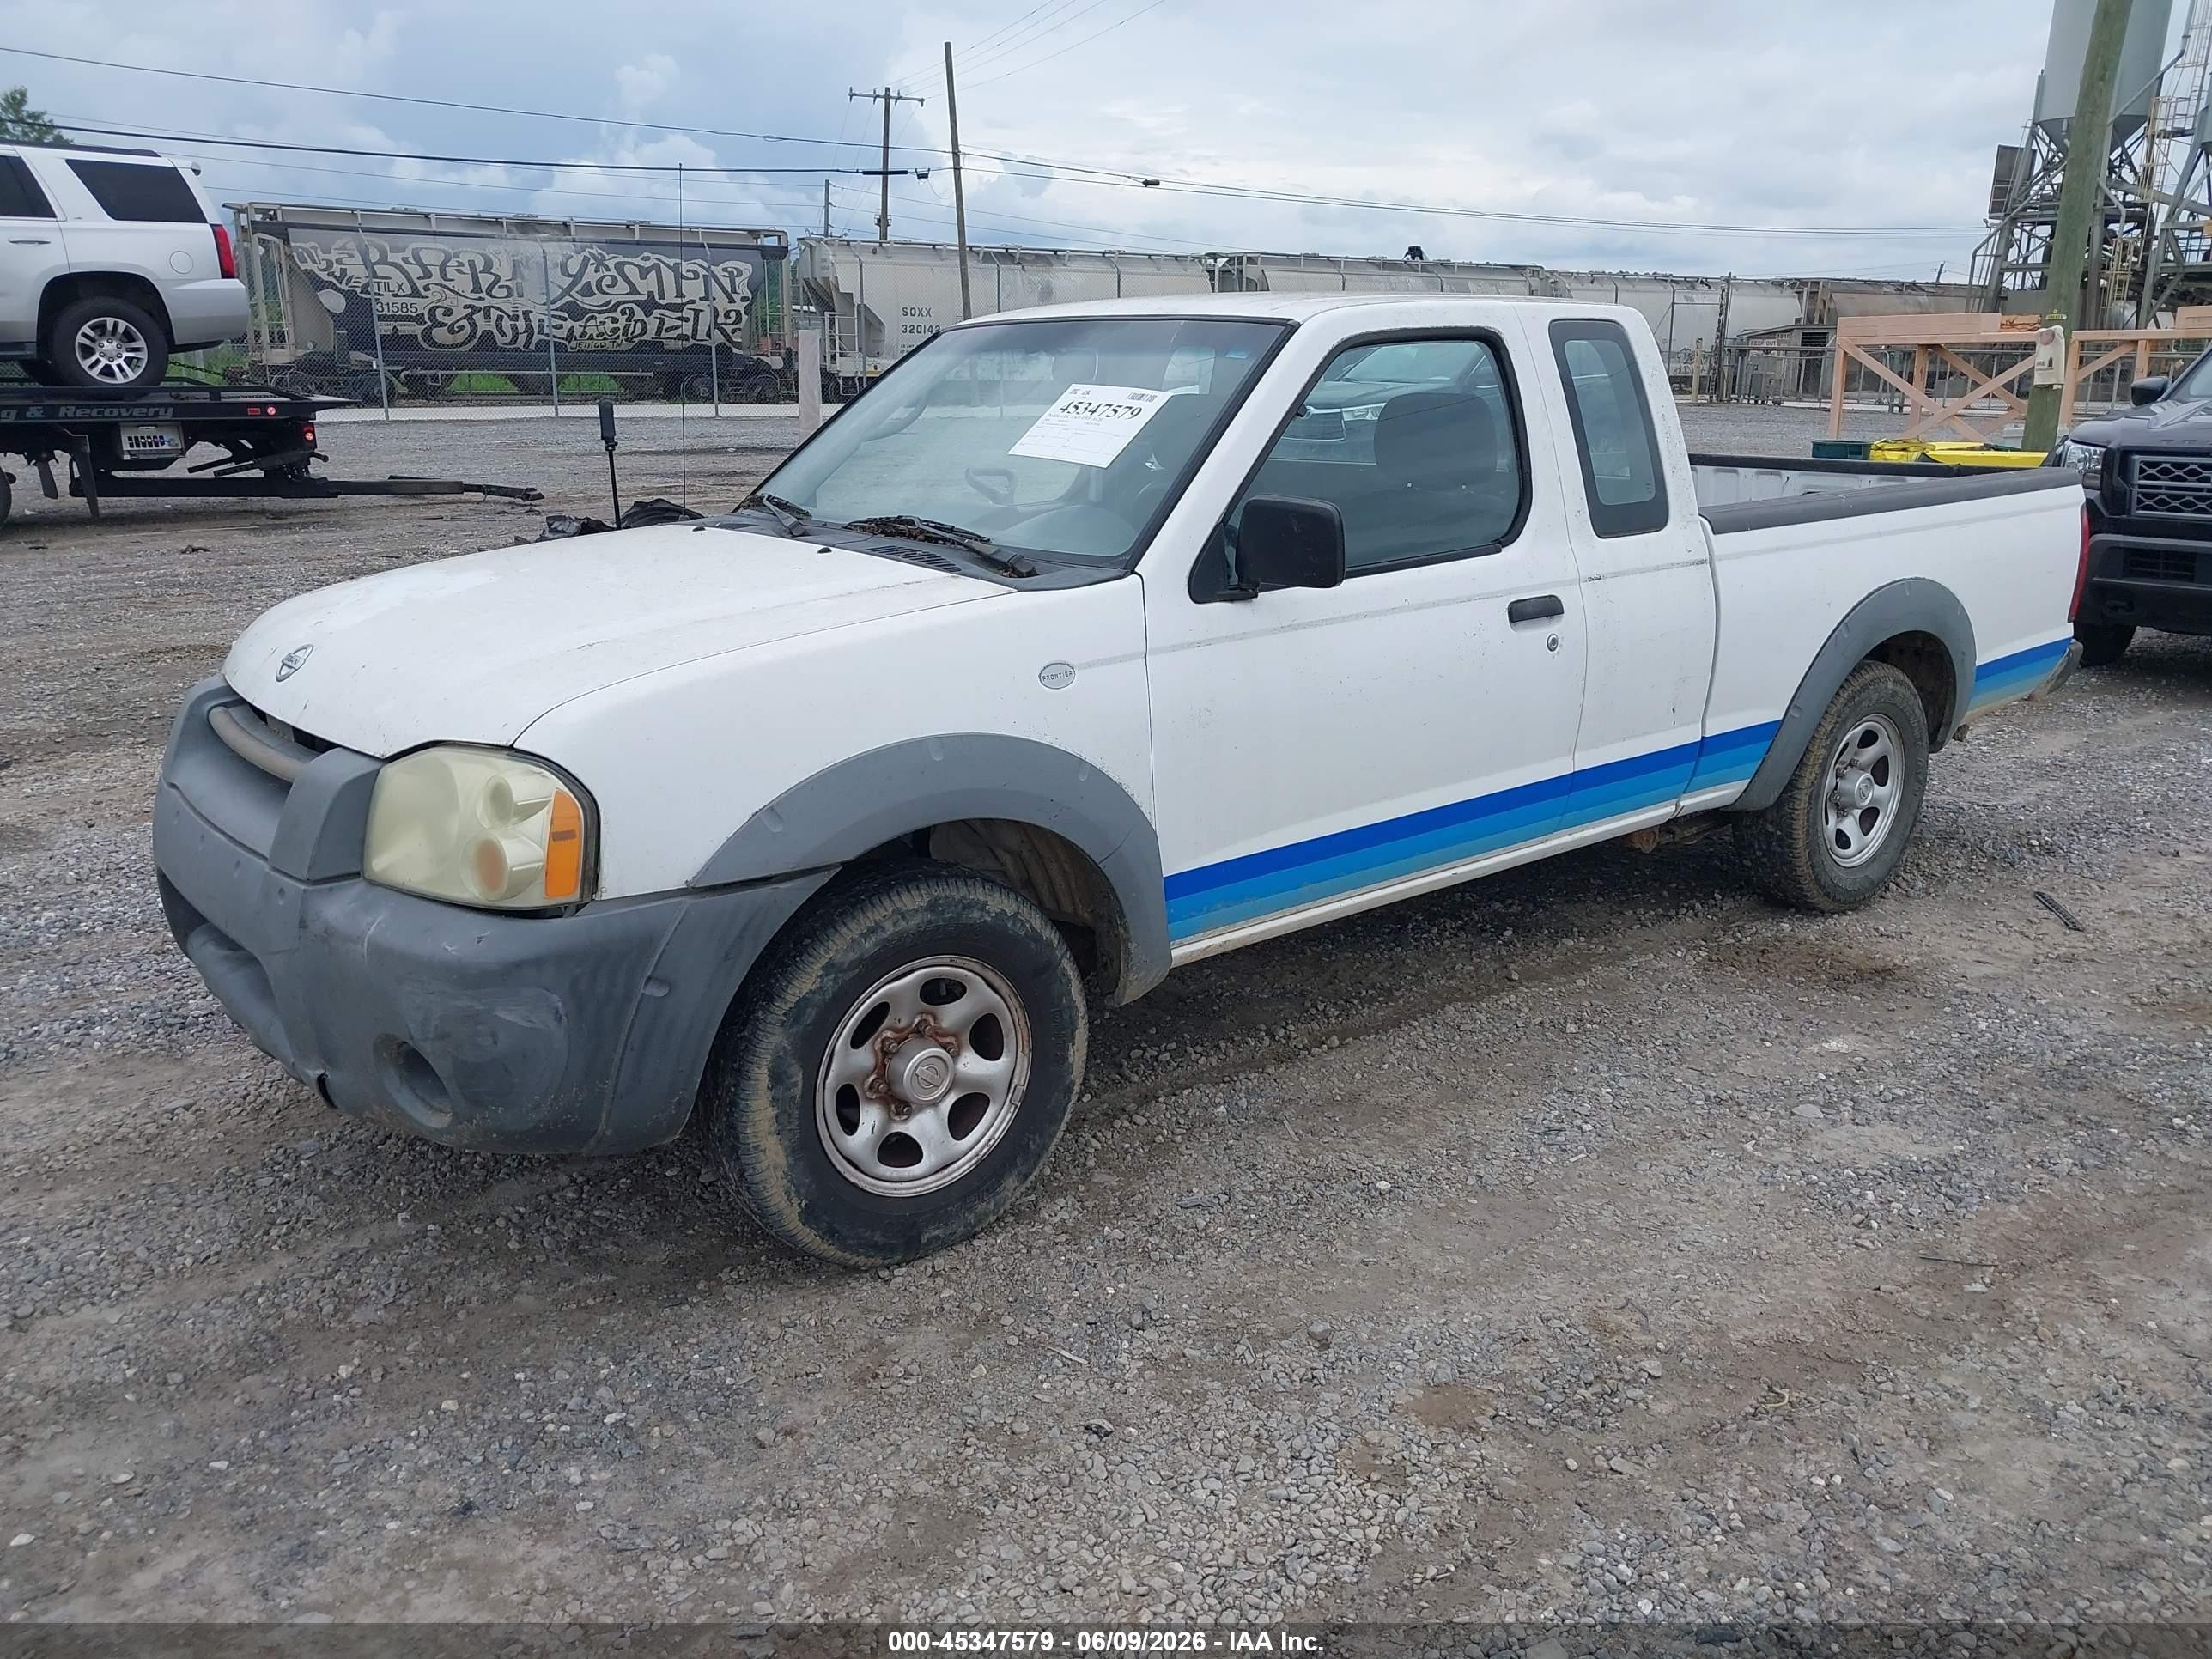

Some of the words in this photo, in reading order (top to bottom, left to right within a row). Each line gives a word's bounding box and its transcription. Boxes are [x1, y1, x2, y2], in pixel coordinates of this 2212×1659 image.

[374, 281, 405, 293] TILX
[376, 301, 418, 313] 31585
[902, 307, 932, 318] SOXX
[58, 405, 173, 420] Recovery
[1060, 400, 1143, 420] 45347579
